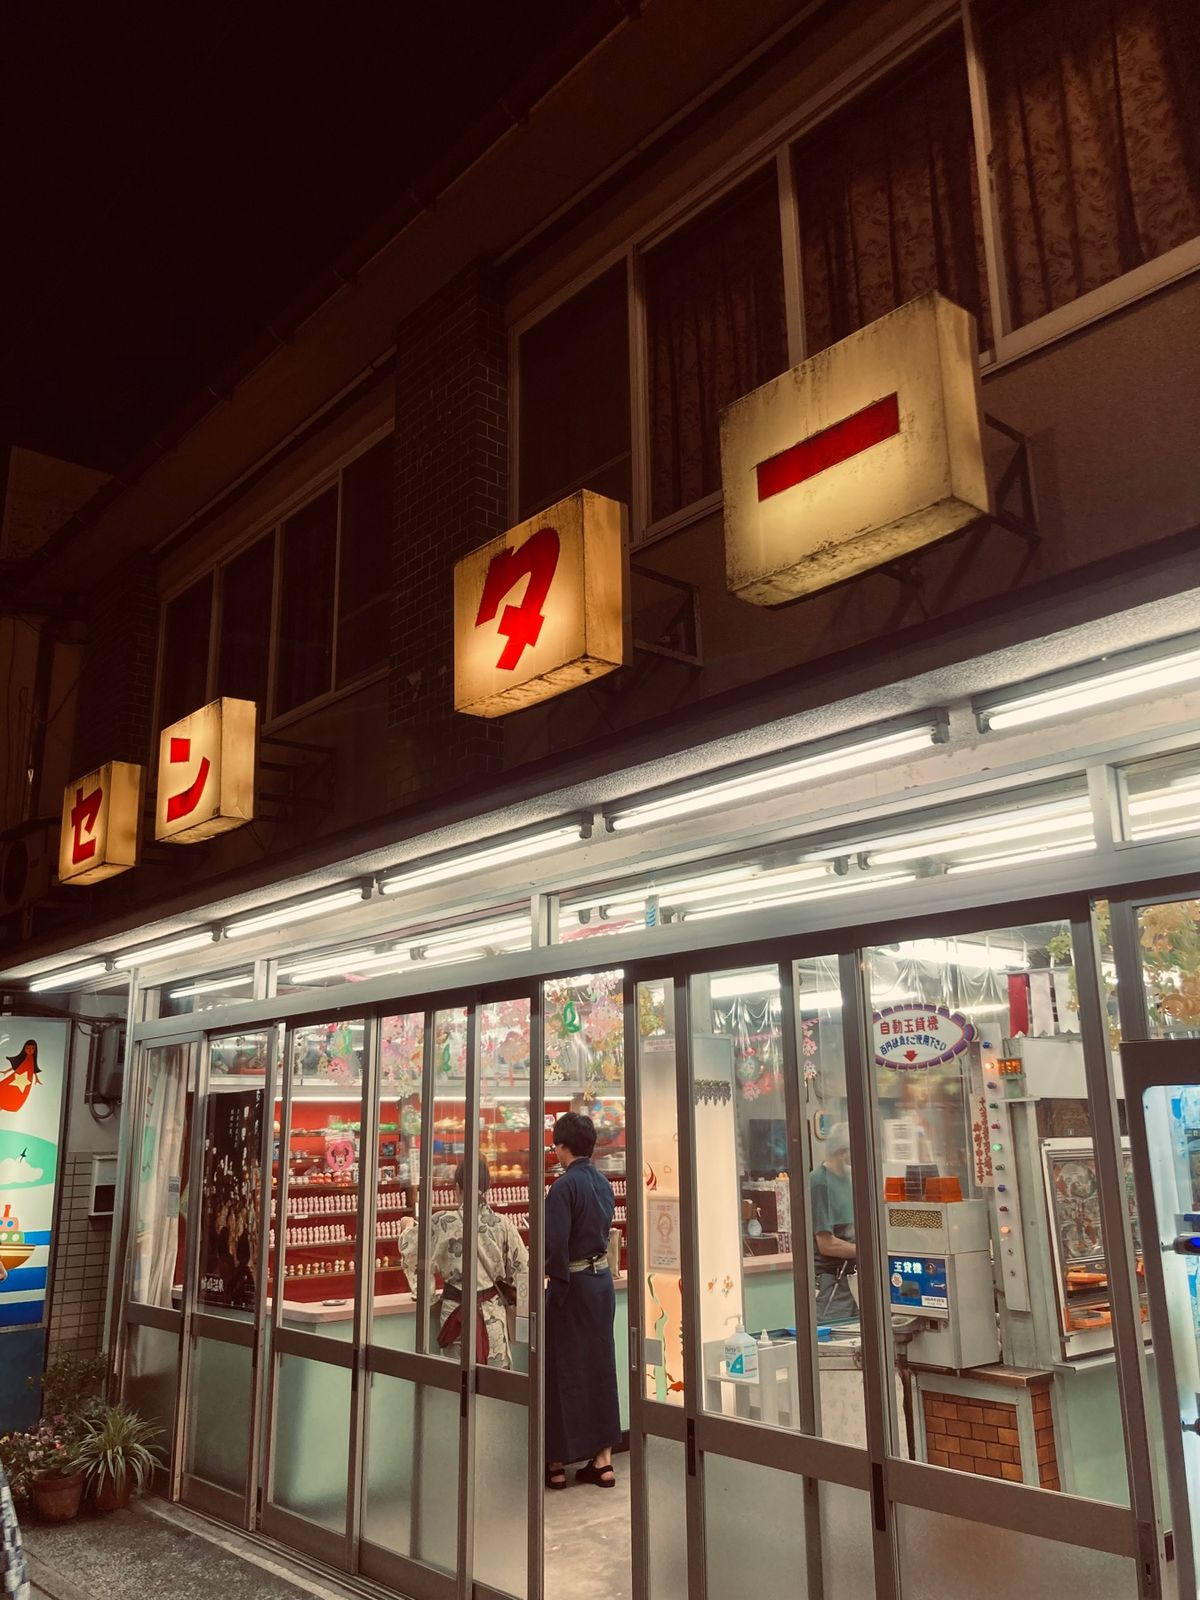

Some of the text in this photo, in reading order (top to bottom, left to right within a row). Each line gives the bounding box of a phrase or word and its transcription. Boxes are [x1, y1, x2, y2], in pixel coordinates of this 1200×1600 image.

[880, 1016, 938, 1035] 自動玉貸機
[893, 1261, 923, 1274] 玉貸機
